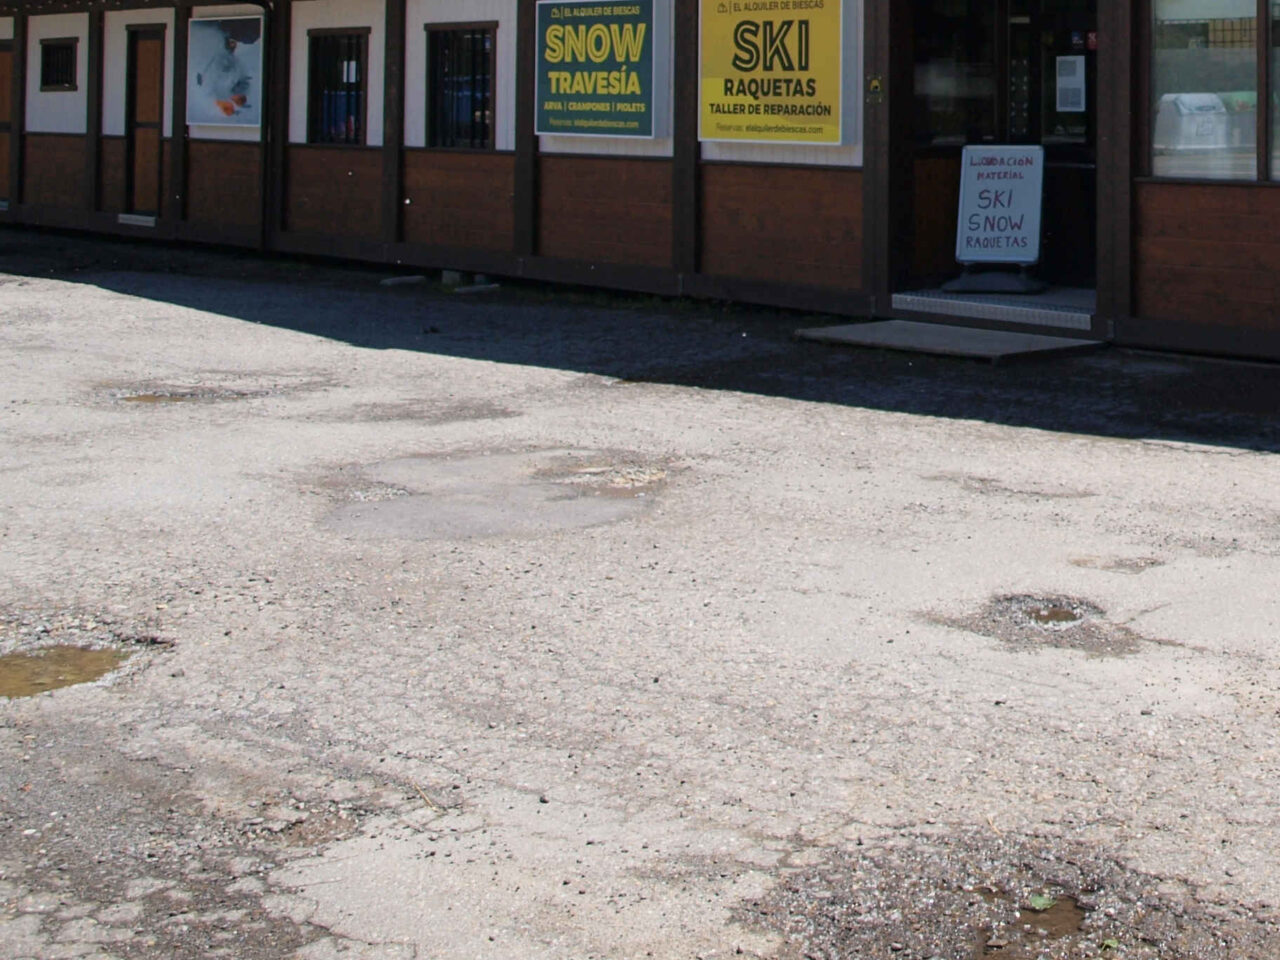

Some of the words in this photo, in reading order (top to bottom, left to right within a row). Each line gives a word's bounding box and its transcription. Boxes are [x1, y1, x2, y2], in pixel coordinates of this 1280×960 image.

[733, 2, 741, 12] EL
[743, 1, 779, 12] ALQUILER
[780, 0, 790, 10] DE
[792, 0, 824, 10] BIESCAS
[544, 23, 646, 63] SNOW
[731, 19, 809, 72] SKI
[548, 65, 641, 95] TRAVESÍA
[724, 78, 816, 100] RAQUETAS
[709, 103, 745, 115] TALLER
[748, 104, 761, 115] DE
[763, 100, 831, 116] REPARACIÓN
[977, 189, 1013, 209] SKI
[968, 213, 1024, 232] SNOW
[966, 235, 1028, 248] RAQUETAS
